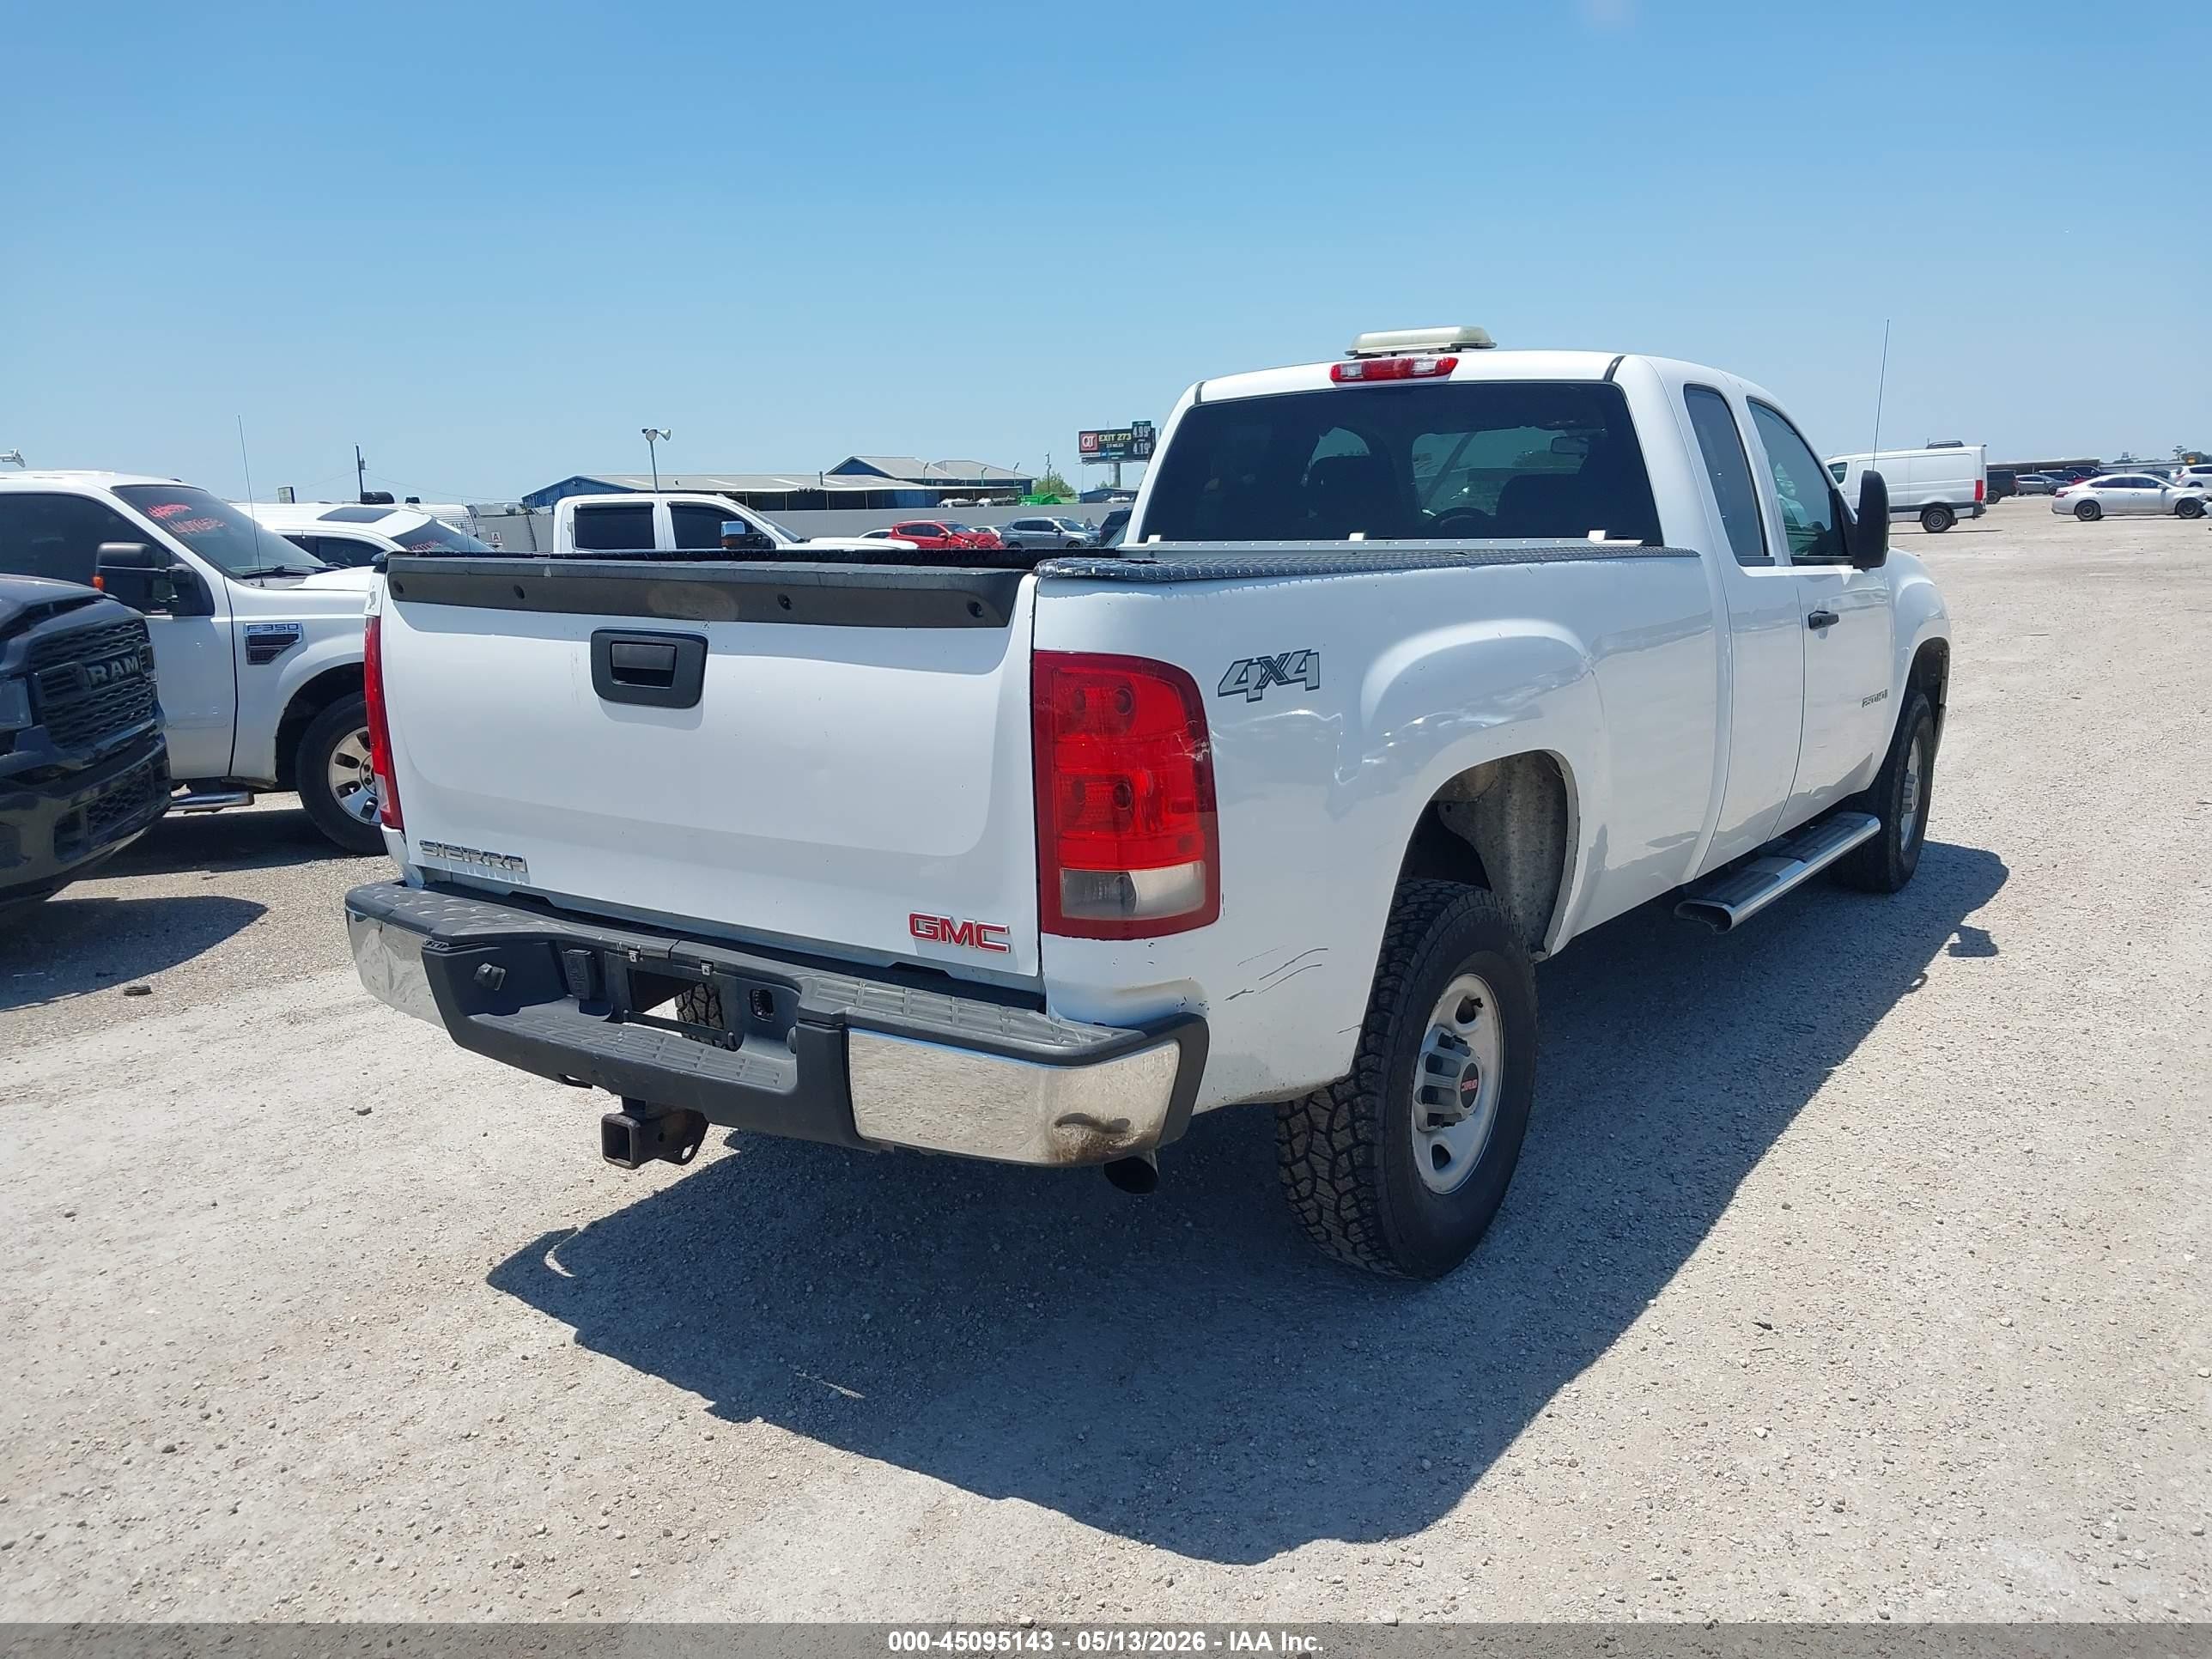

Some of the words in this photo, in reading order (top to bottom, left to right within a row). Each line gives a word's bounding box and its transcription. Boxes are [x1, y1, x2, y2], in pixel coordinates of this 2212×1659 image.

[88, 655, 139, 684] RAM
[419, 839, 528, 873] SIERRA
[909, 911, 1011, 953] GMC
